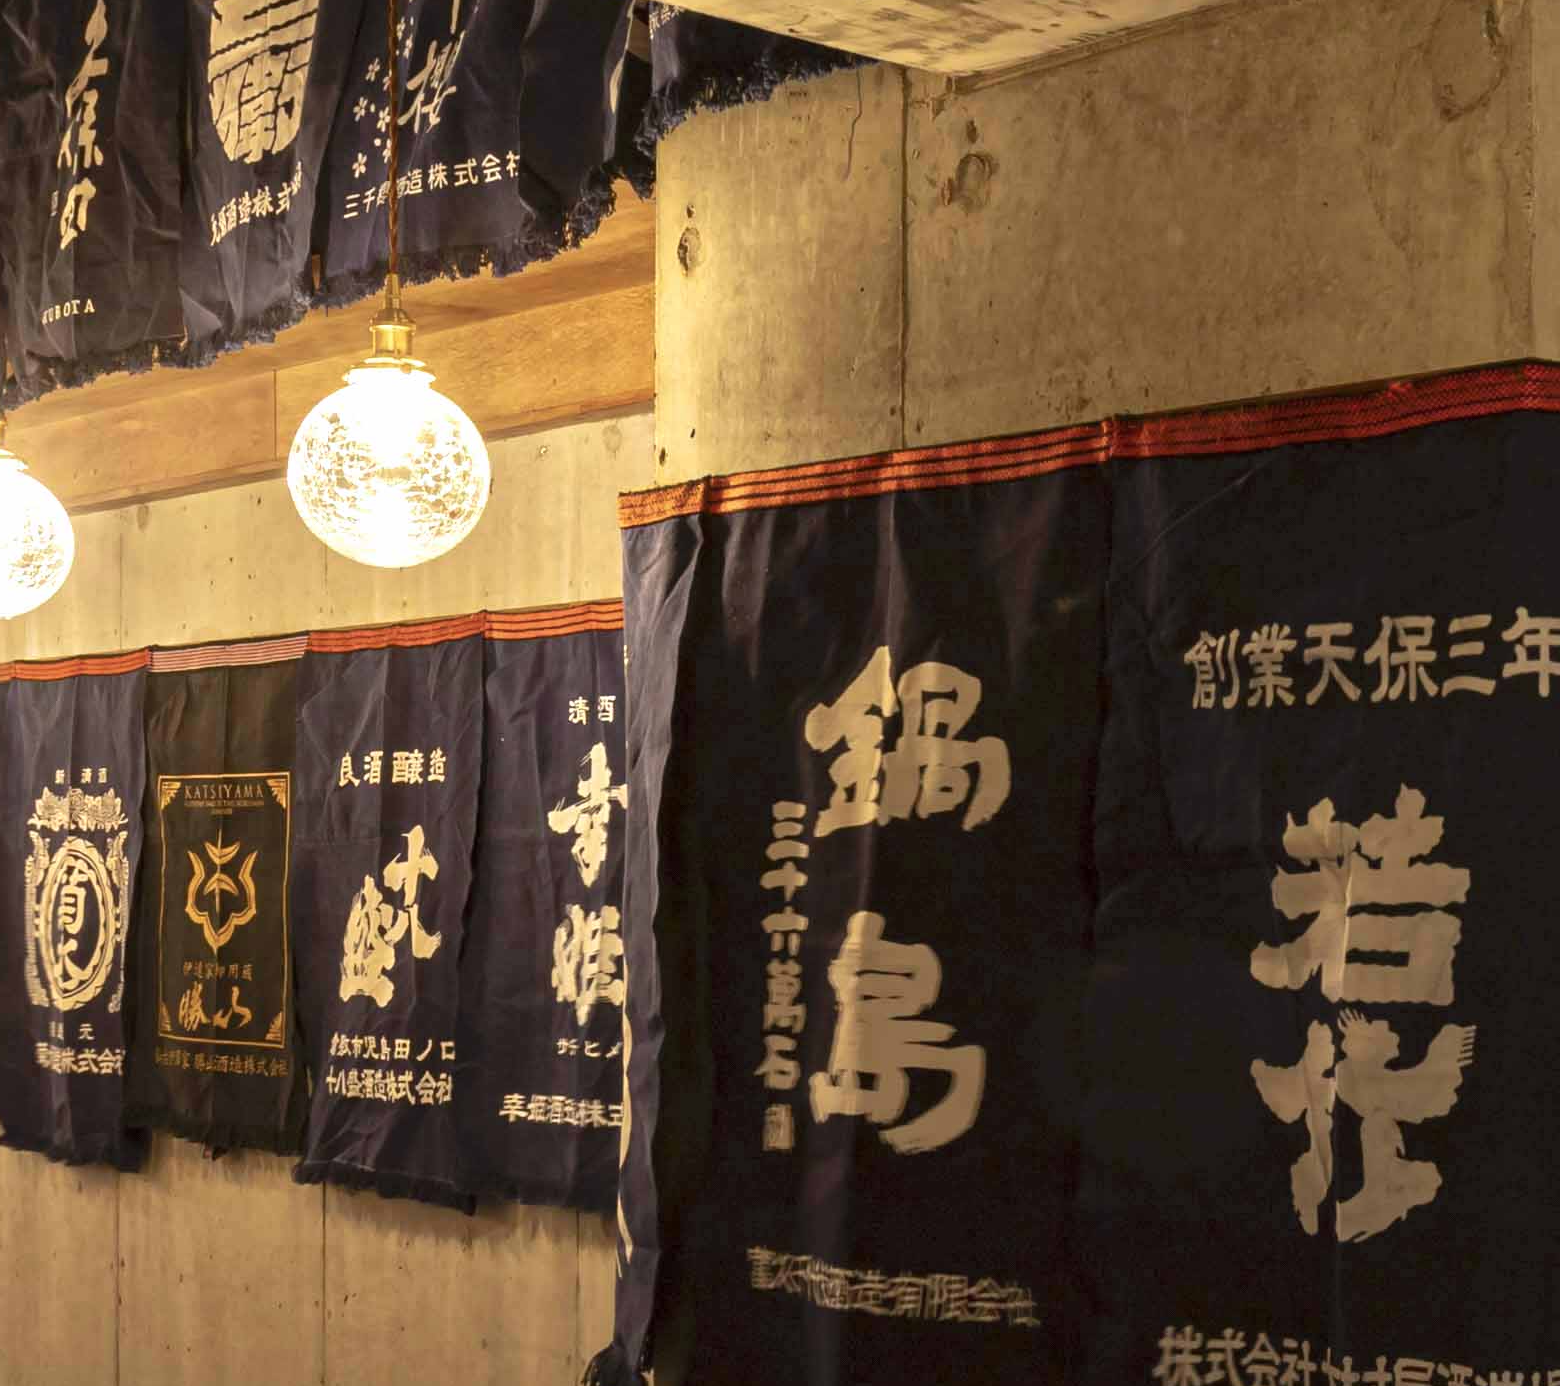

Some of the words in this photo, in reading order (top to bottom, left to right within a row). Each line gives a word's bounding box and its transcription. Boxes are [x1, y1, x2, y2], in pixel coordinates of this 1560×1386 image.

[338, 748, 448, 788] 良酒醸造
[804, 644, 1013, 1155] 鍋島
